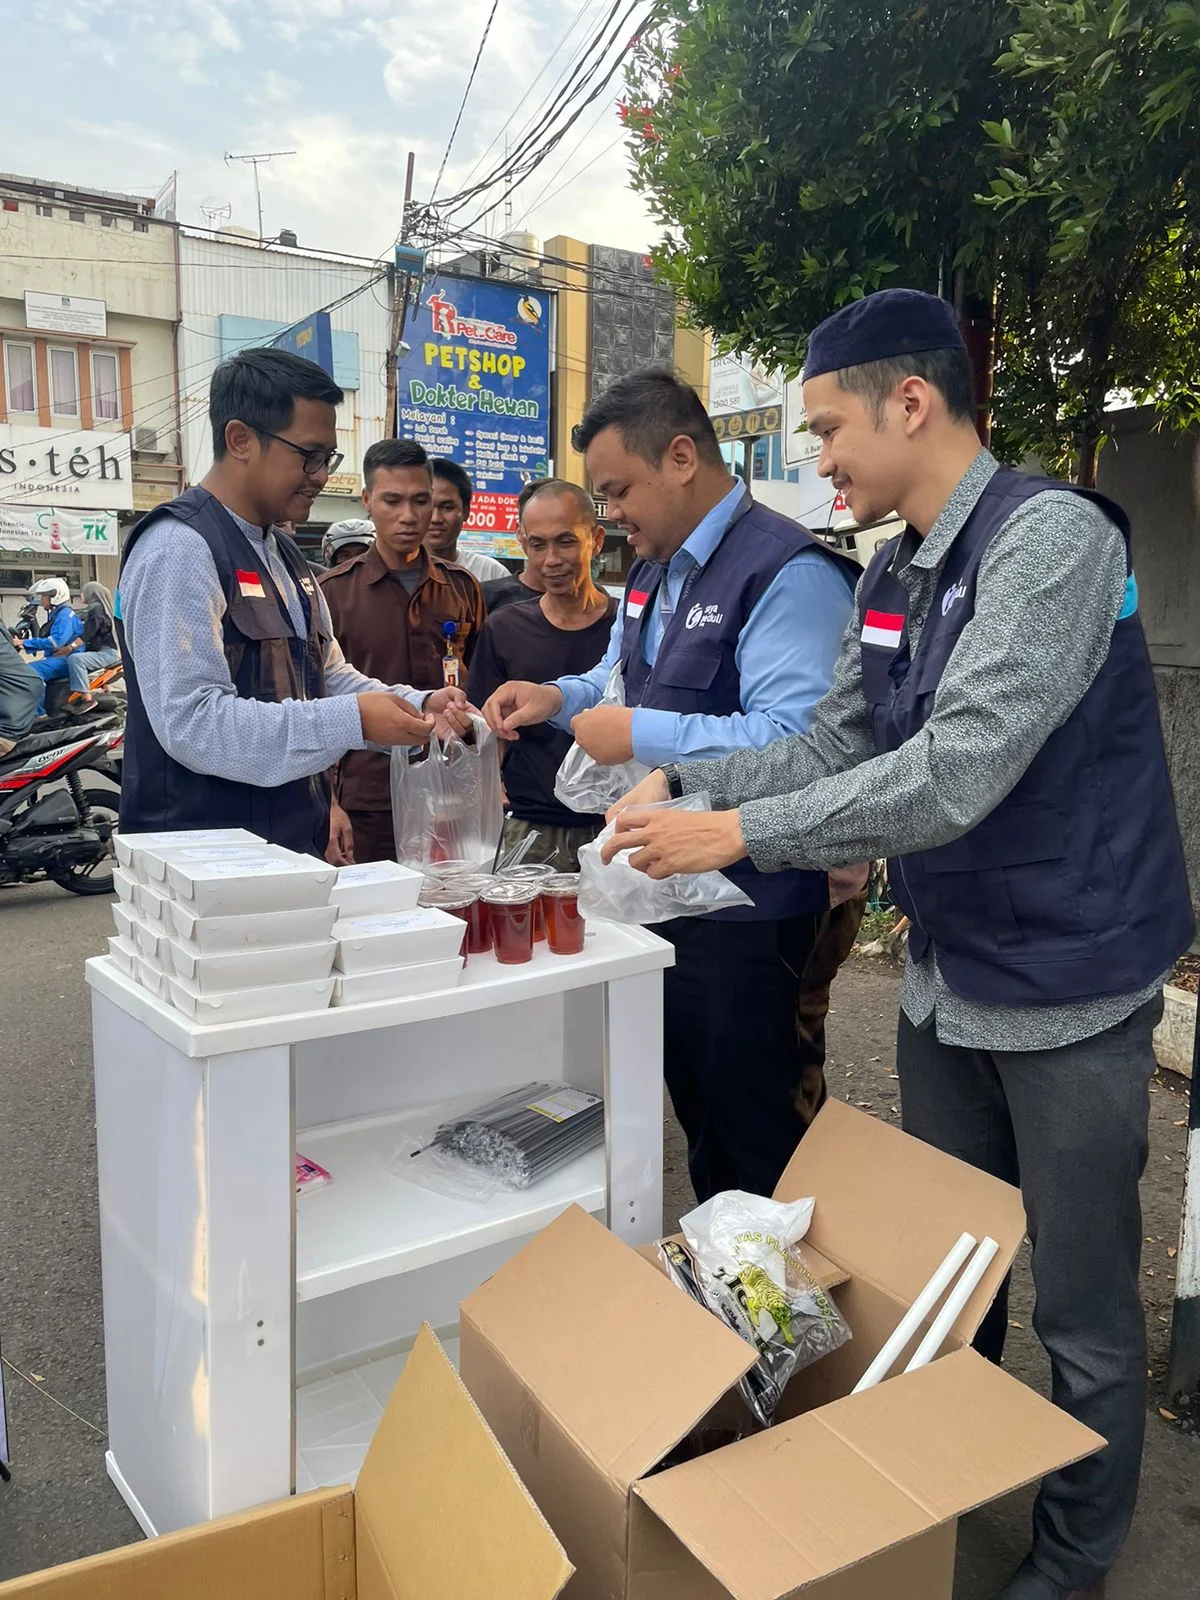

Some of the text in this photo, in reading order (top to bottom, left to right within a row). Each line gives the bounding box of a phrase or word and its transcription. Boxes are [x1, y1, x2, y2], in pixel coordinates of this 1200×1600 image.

[424, 343, 525, 377] PETSHOP
[467, 375, 482, 390] &
[410, 380, 539, 418] Dokter Hewan
[401, 408, 446, 424] Melayani
[14, 483, 80, 493] INDONESIA
[463, 512, 495, 527] 000
[83, 524, 108, 541] 7K
[736, 1231, 762, 1243] TAS
